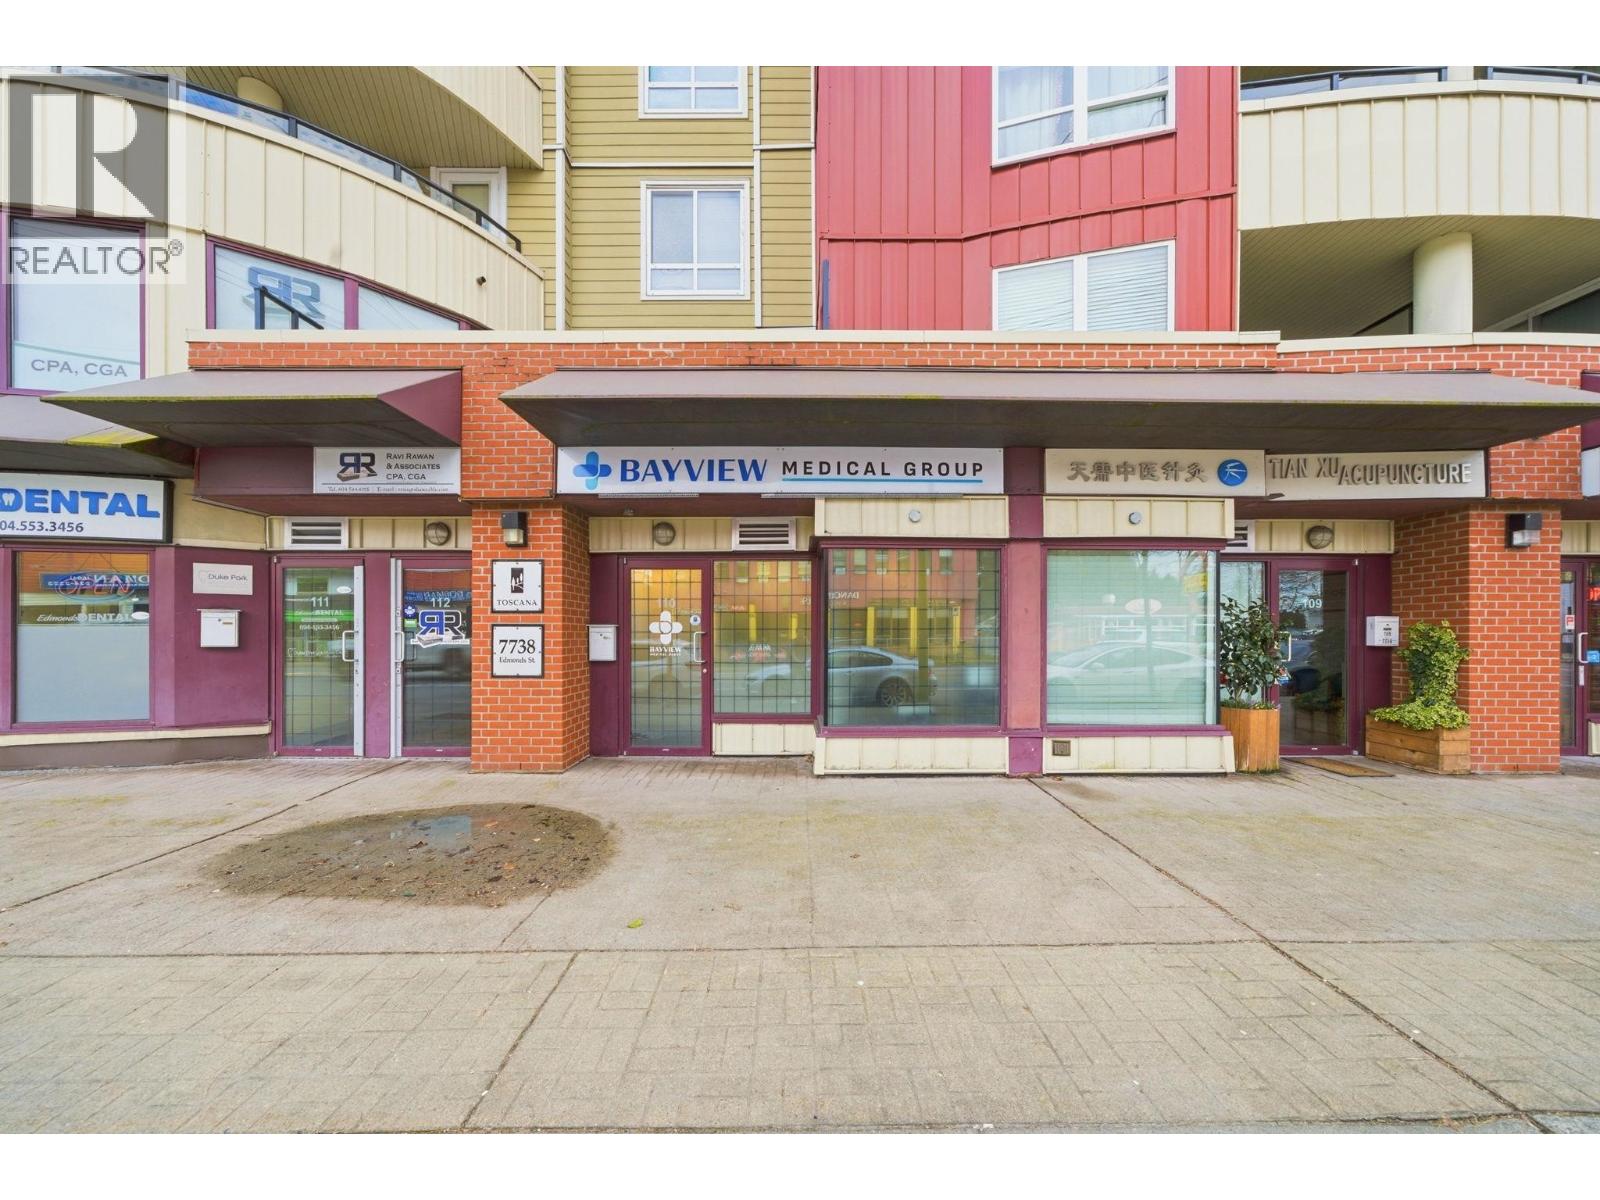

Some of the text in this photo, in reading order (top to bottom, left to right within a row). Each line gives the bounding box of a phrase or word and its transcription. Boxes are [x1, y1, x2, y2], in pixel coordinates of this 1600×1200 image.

[31, 359, 128, 377] CPA, CGA
[620, 458, 983, 482] BAYVIEW MEDICAL GROUP
[1268, 456, 1473, 486] TIAN XU ACUPUNCTURE
[0, 488, 161, 519] DENTAL
[311, 596, 329, 607] 111
[431, 598, 451, 608] 112
[1303, 599, 1323, 608] 109
[77, 613, 130, 622] DENTAL
[499, 639, 536, 654] 7738
